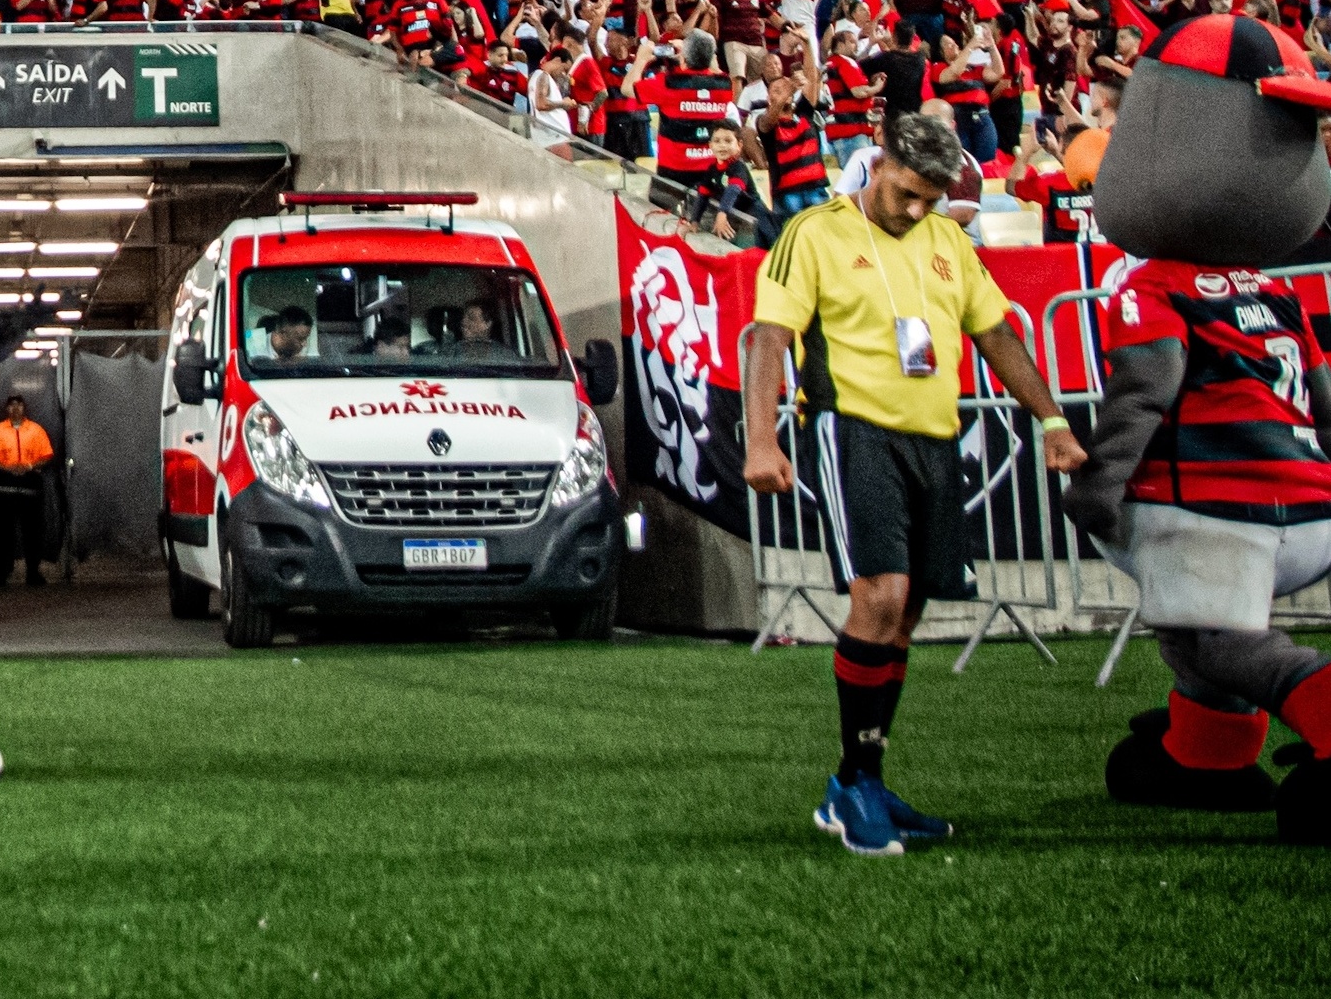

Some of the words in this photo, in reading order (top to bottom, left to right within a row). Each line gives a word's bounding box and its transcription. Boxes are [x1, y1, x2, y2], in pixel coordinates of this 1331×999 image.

[139, 48, 161, 56] NORTH
[15, 60, 88, 83] SAÍDA
[32, 87, 73, 104] EXIT
[141, 67, 178, 113] T
[170, 102, 212, 114] NORTE
[412, 548, 476, 564] GBR1B07
